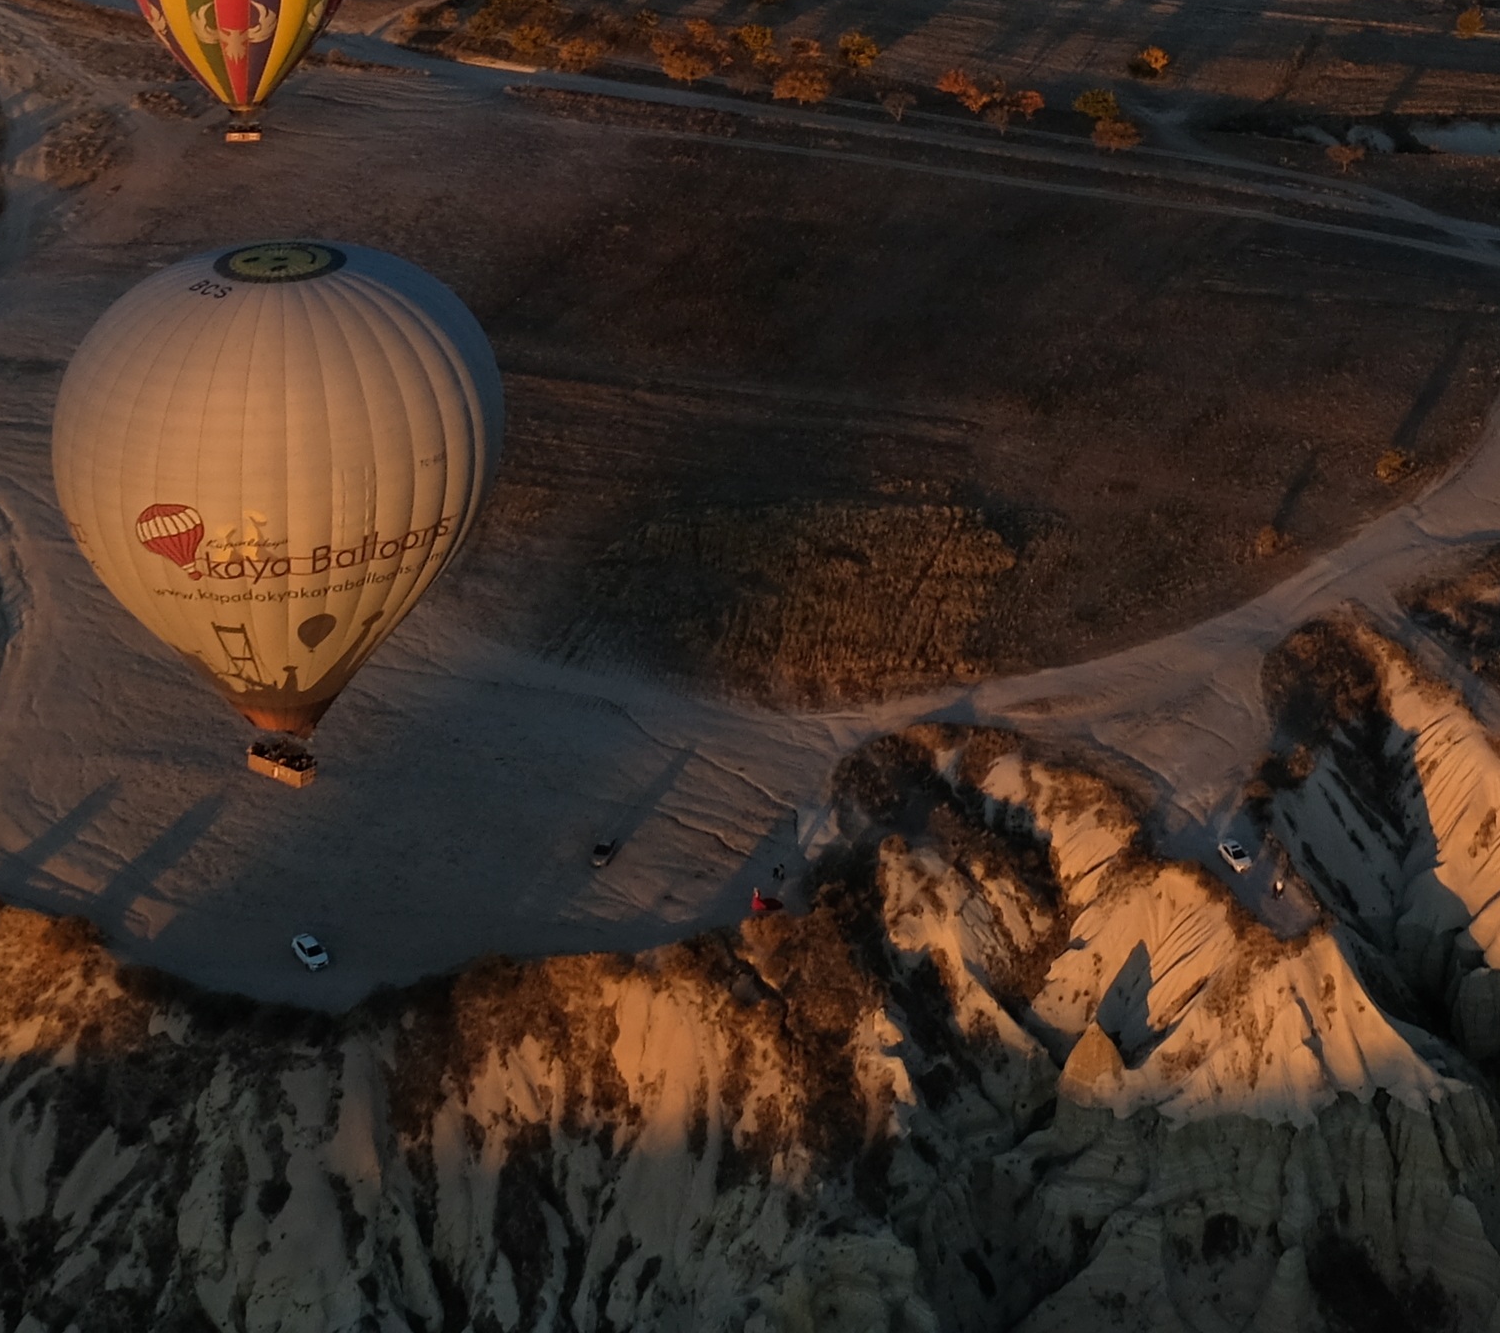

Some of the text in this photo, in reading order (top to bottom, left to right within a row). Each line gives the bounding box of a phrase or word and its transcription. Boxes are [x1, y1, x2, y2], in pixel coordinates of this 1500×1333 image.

[189, 279, 233, 299] BCS
[205, 519, 451, 584] kaya Balloons
